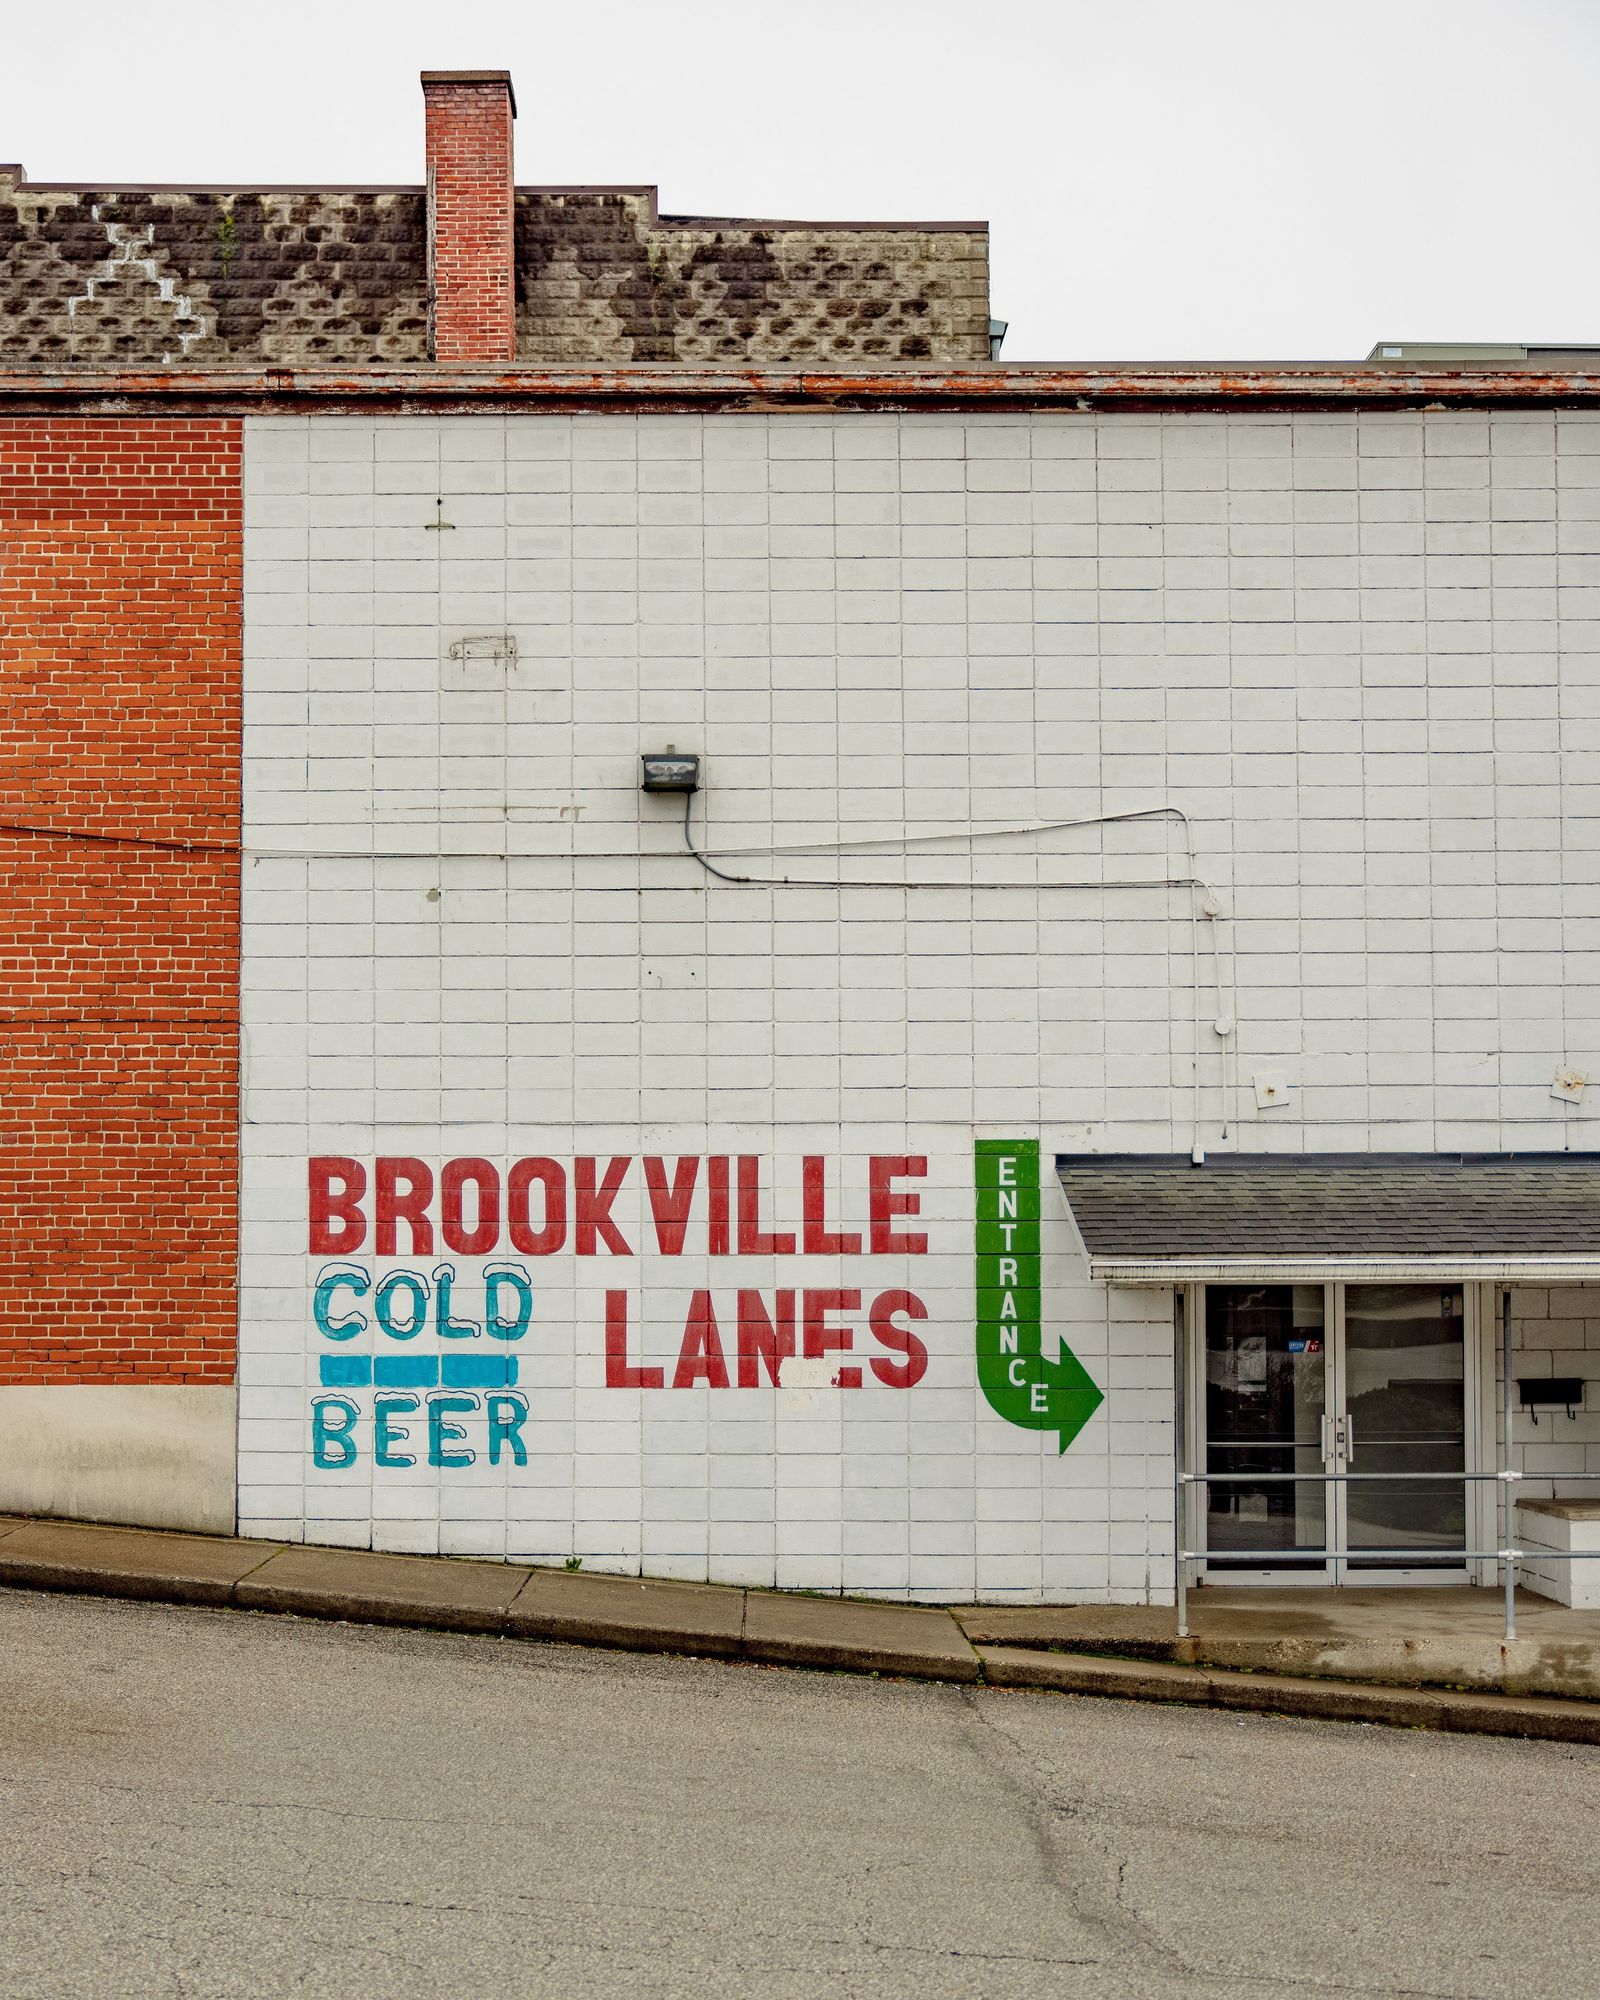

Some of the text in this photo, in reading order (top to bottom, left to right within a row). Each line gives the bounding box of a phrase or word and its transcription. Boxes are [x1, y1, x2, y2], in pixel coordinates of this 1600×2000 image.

[308, 1156, 928, 1256] BROOKVILLE
[313, 1262, 533, 1341] COLD
[998, 1157, 1049, 1412] ENTRANCE
[605, 1289, 928, 1389] LANES
[311, 1390, 529, 1469] BEER
